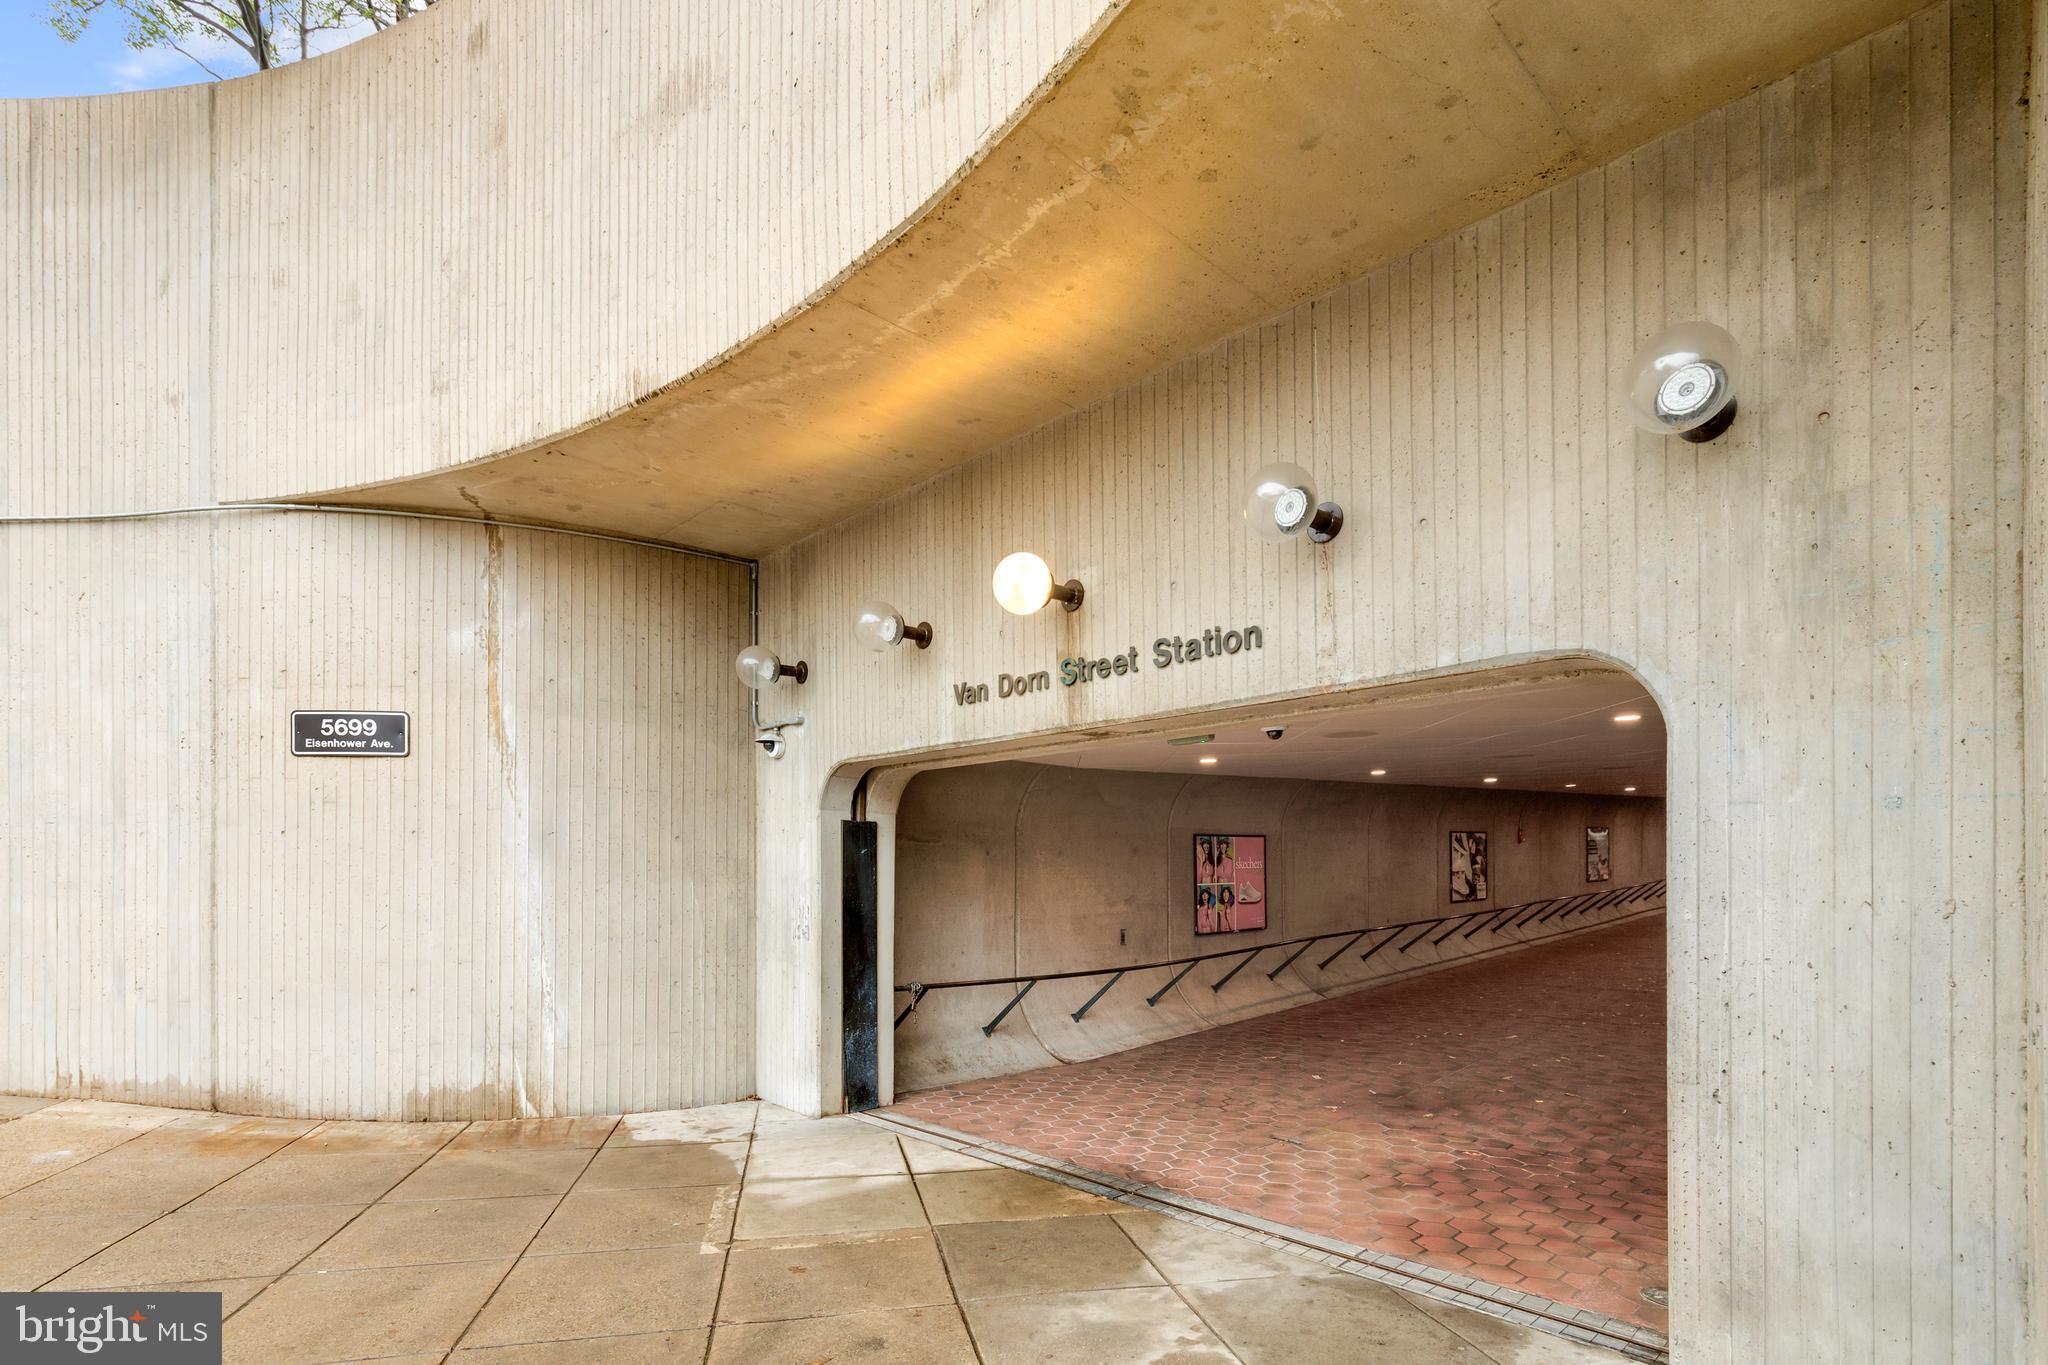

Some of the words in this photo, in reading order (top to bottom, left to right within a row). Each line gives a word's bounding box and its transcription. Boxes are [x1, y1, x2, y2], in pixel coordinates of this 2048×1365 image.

[953, 681, 989, 706] Van
[998, 669, 1050, 698] Dorn
[1060, 646, 1139, 686] Street
[1152, 624, 1263, 668] Station
[320, 719, 377, 736] 5699
[305, 738, 366, 748] Eisenhower
[370, 739, 394, 748] Ave.
